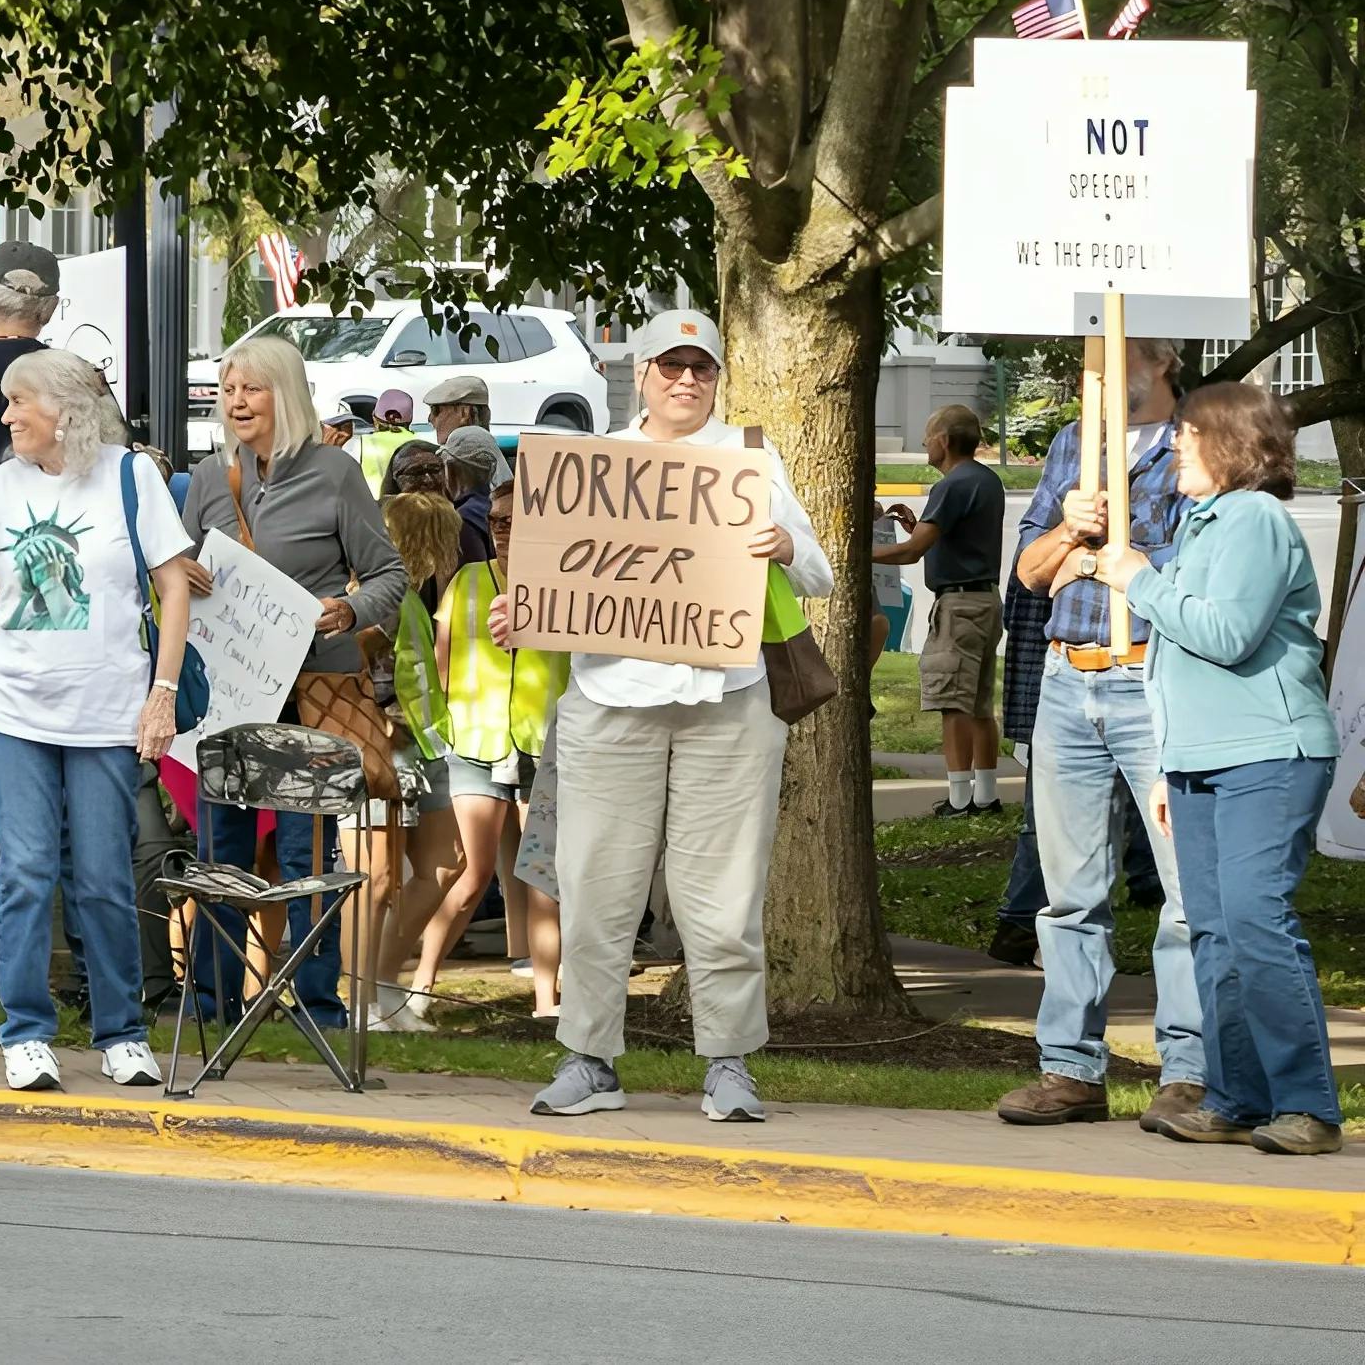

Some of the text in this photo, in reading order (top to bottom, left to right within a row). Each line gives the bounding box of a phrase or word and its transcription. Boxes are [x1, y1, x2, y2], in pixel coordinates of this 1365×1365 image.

[1086, 117, 1150, 156] NOT
[1017, 241, 1041, 266] WE
[1054, 241, 1082, 267] THE
[519, 450, 761, 528] WORKERS
[559, 538, 696, 585] OVER
[512, 584, 753, 650] BILLIONAIRES
